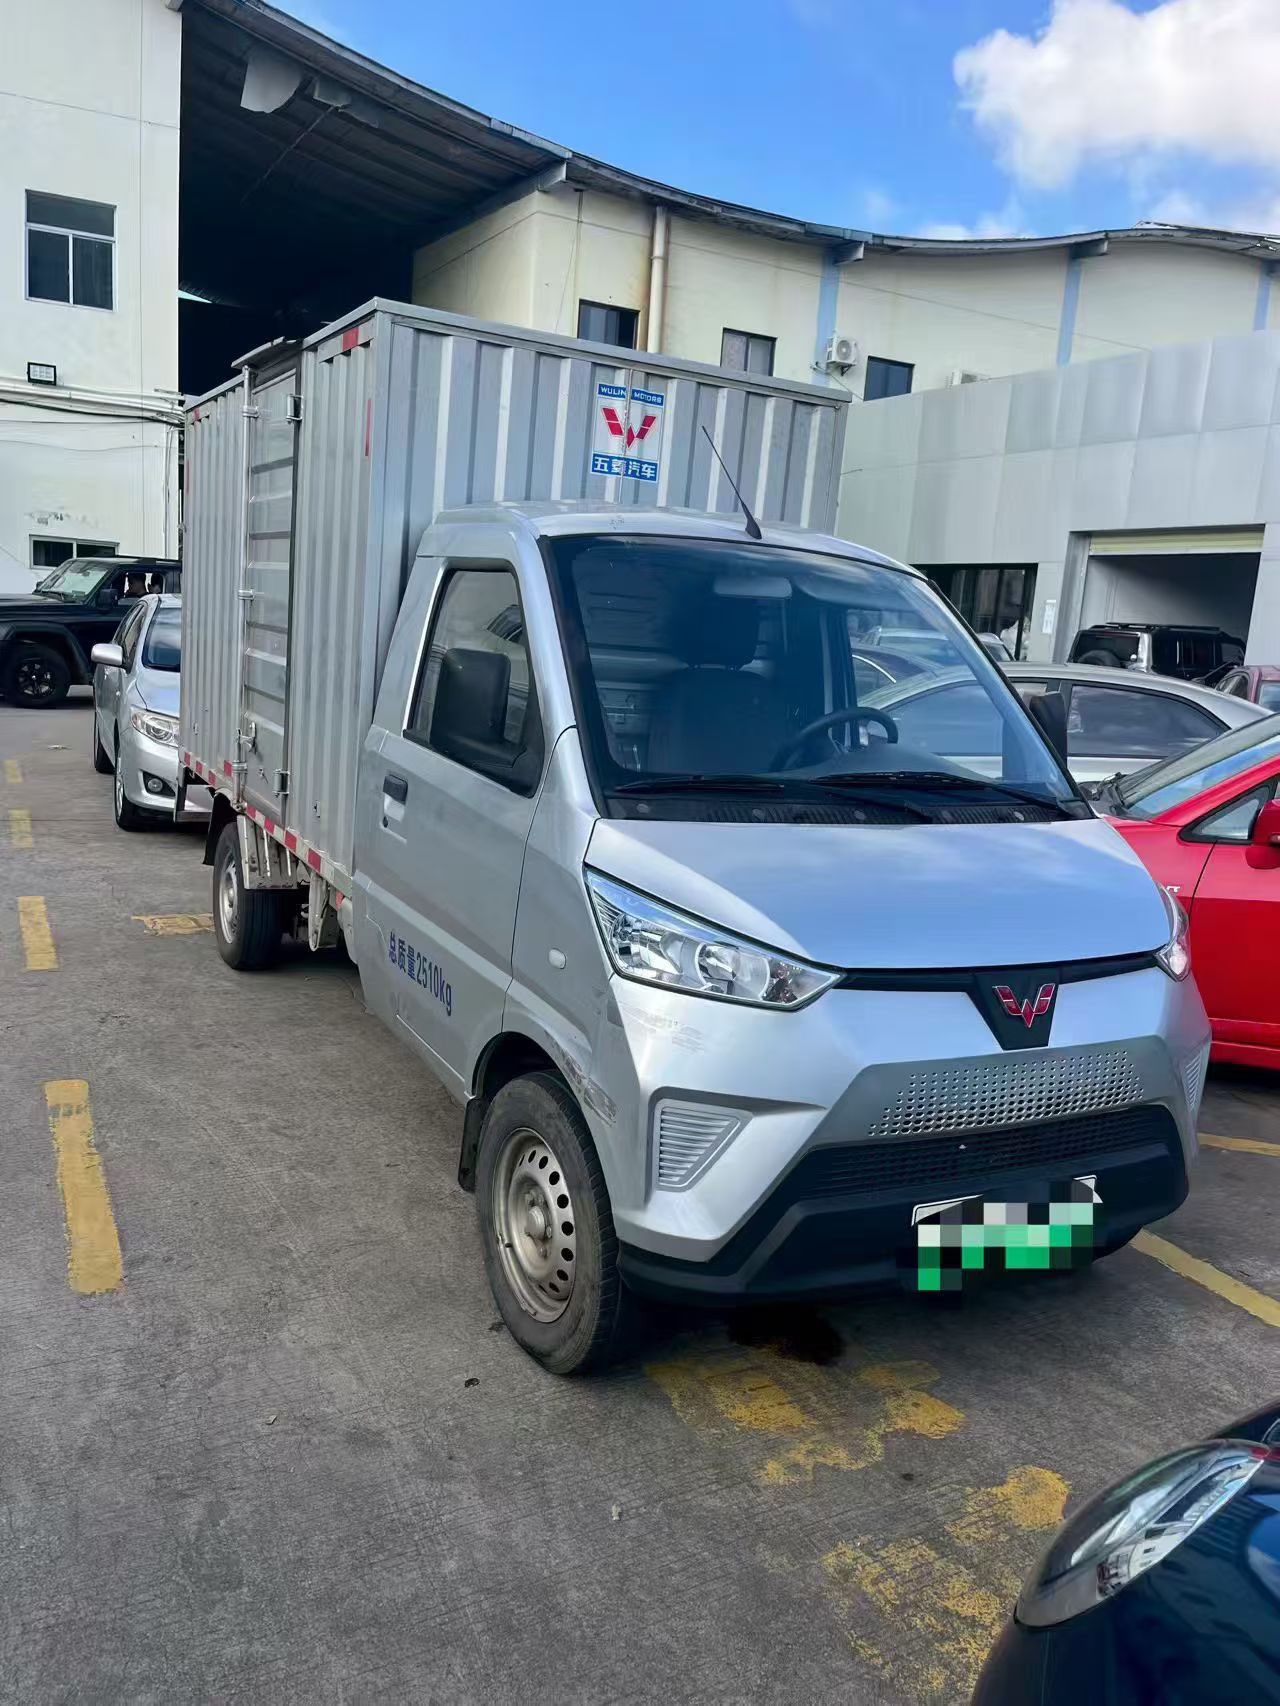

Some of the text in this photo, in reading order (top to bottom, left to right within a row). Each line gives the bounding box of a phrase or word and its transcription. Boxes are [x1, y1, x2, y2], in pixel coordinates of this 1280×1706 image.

[600, 386, 662, 404] WULIN MOTORS
[389, 931, 452, 1017] 总质量2510kg
